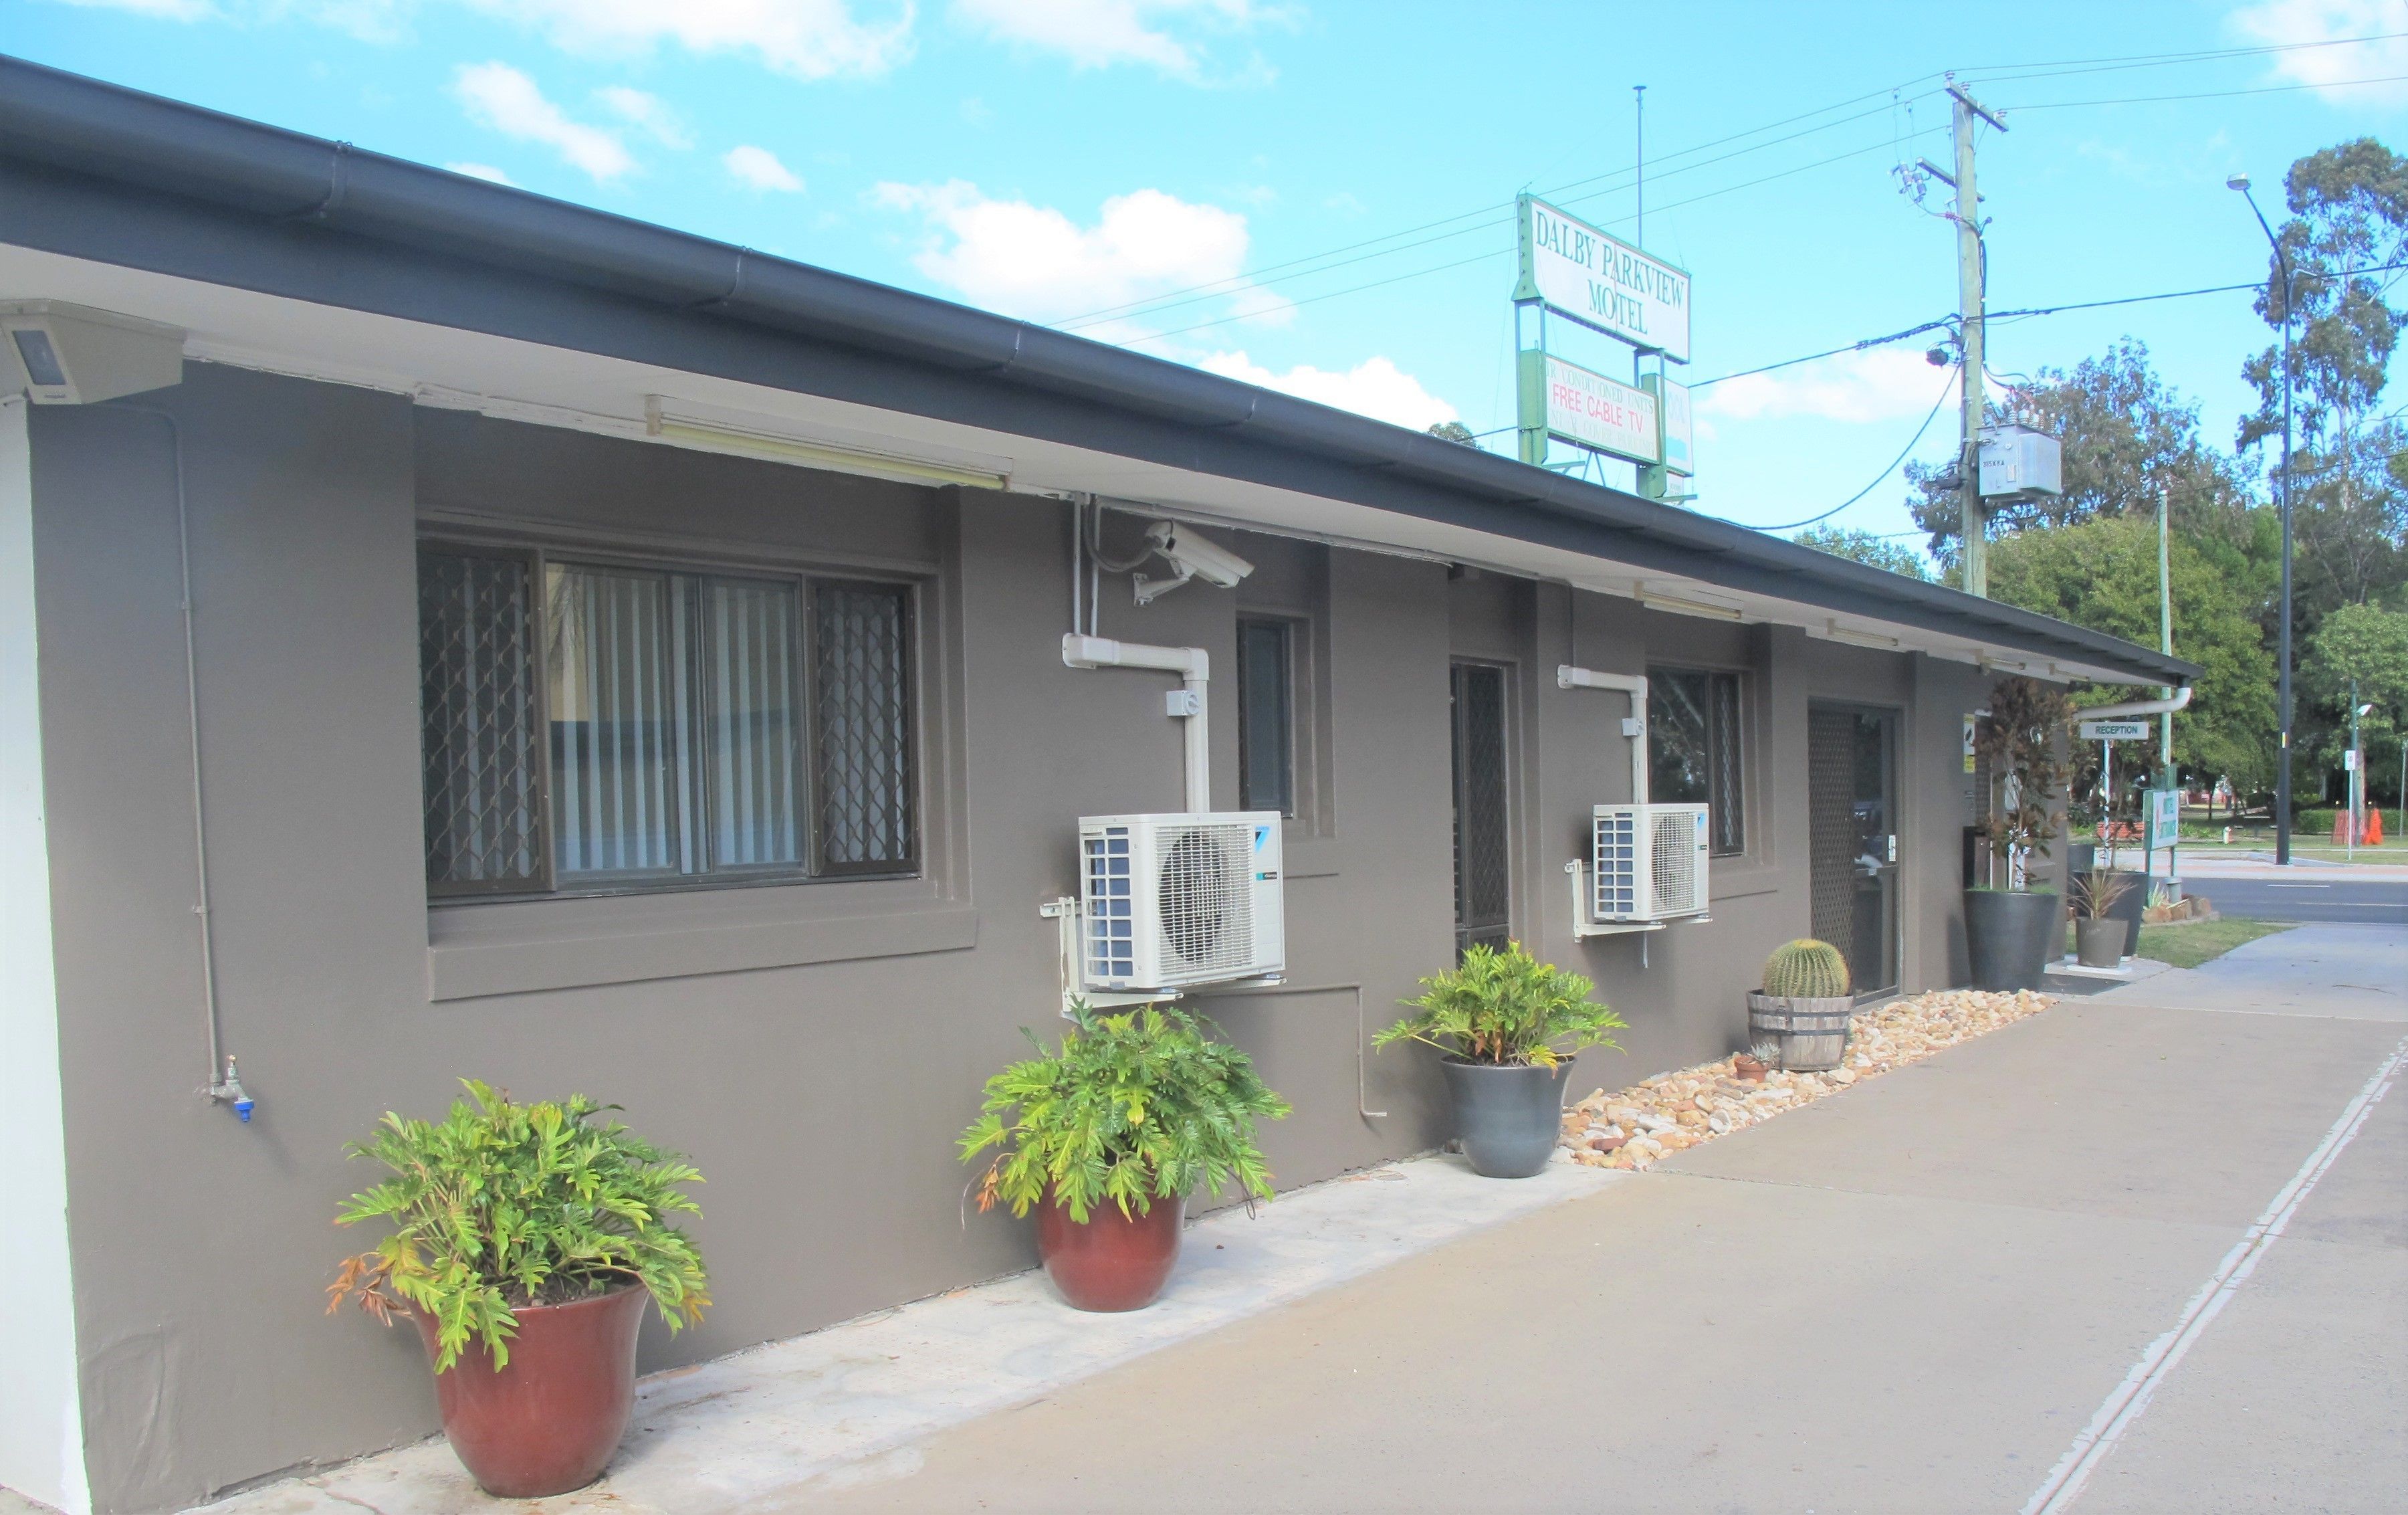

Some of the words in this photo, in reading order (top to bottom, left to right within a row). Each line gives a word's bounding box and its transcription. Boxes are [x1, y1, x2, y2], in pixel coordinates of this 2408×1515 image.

[1536, 210, 1596, 270] DALBY
[1602, 243, 1684, 310] PARKVIEW
[1588, 279, 1648, 334] MOTEL
[1553, 383, 1581, 413] FREE
[1587, 395, 1623, 427] CABLE
[1628, 410, 1644, 434] TV
[2095, 726, 2138, 734] RECEPTION
